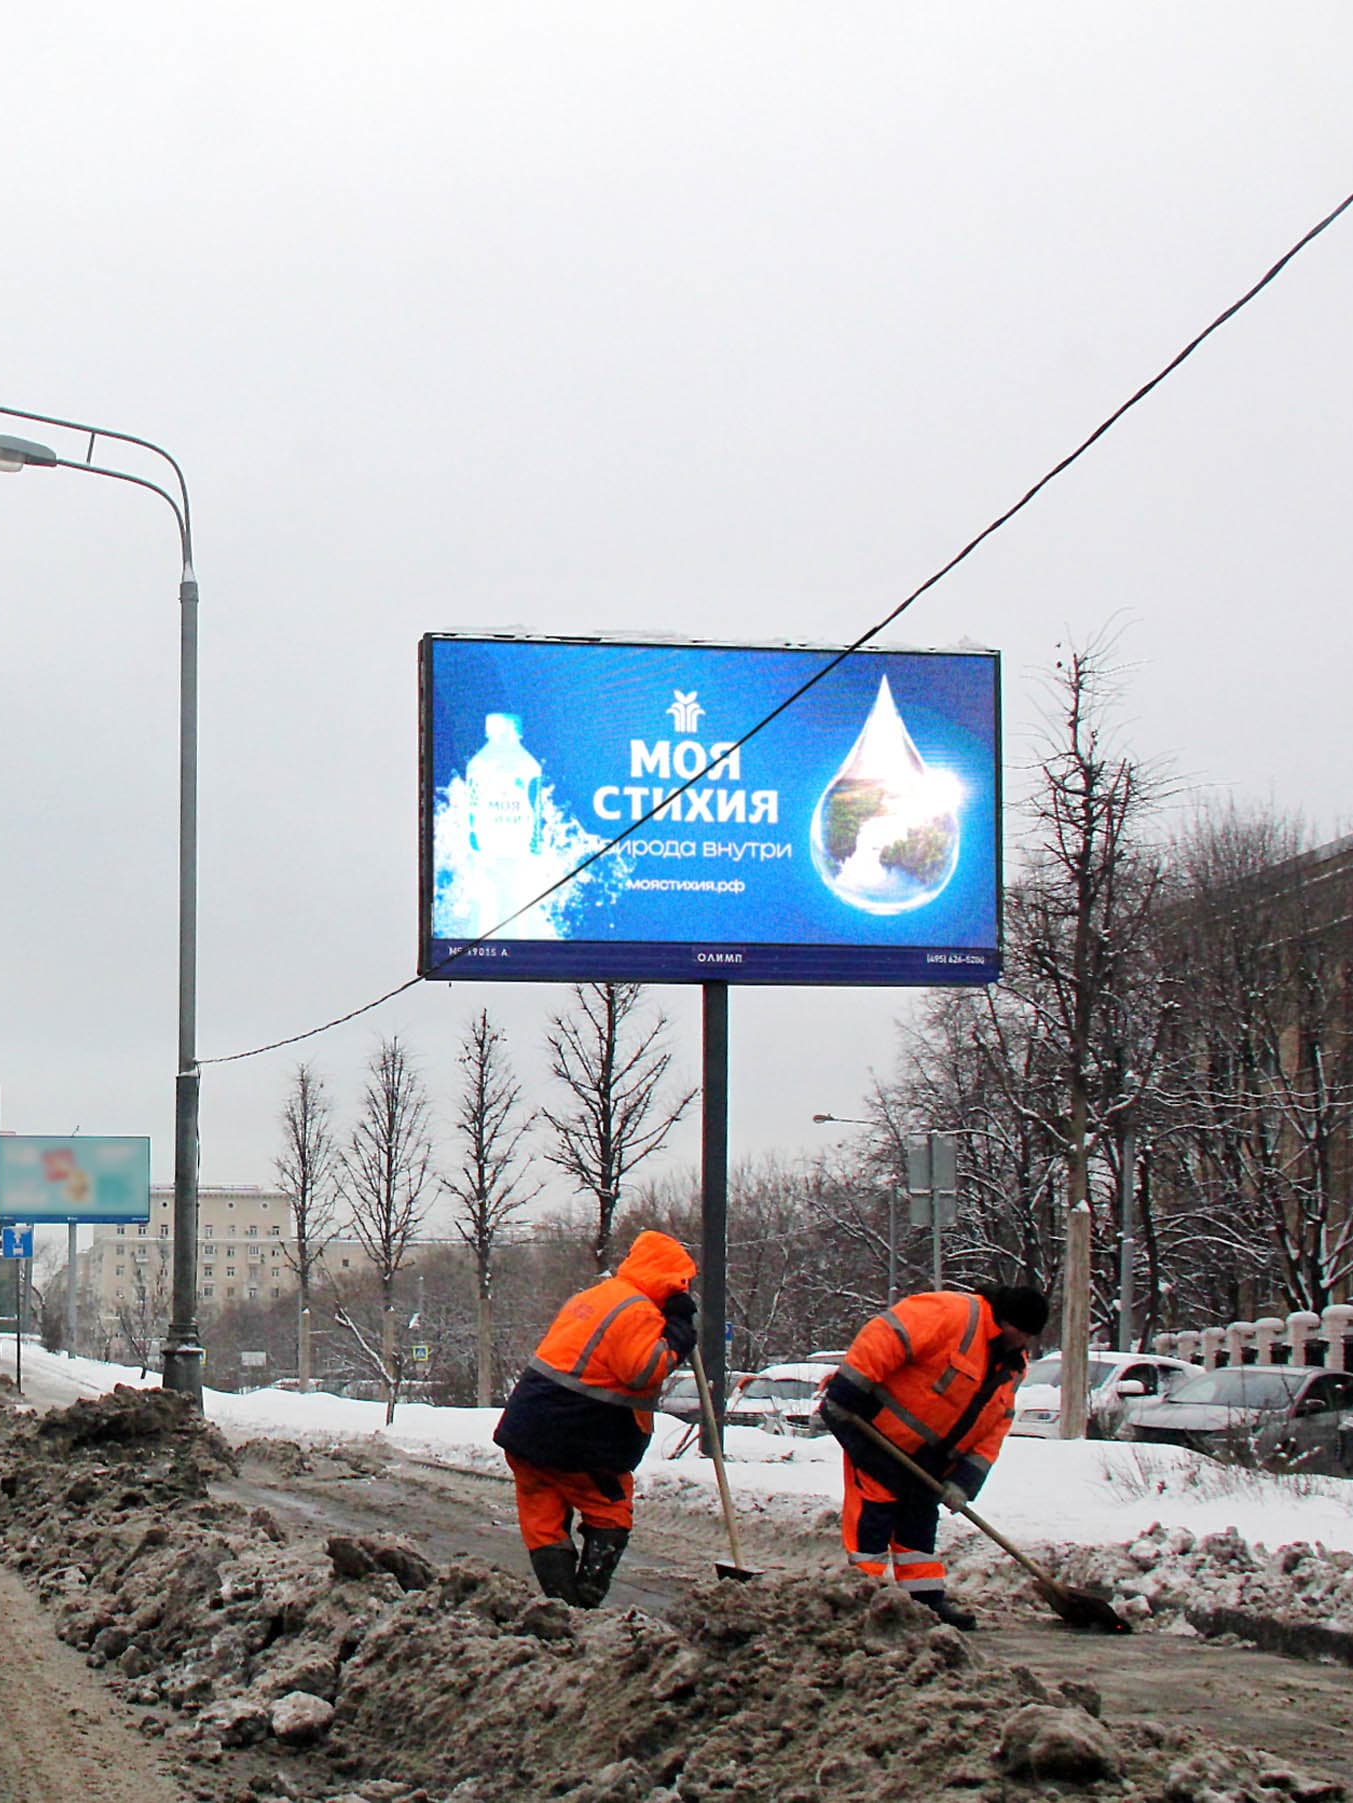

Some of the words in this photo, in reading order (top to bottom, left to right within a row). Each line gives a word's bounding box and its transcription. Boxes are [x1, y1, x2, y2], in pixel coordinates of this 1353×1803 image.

[630, 739, 741, 781] МОЯ
[592, 785, 779, 825] СТИХИЯ
[584, 837, 697, 860] рирода
[703, 840, 792, 862] внутри
[626, 878, 746, 895] моястихия.рф
[696, 952, 743, 964] ОЛИМП
